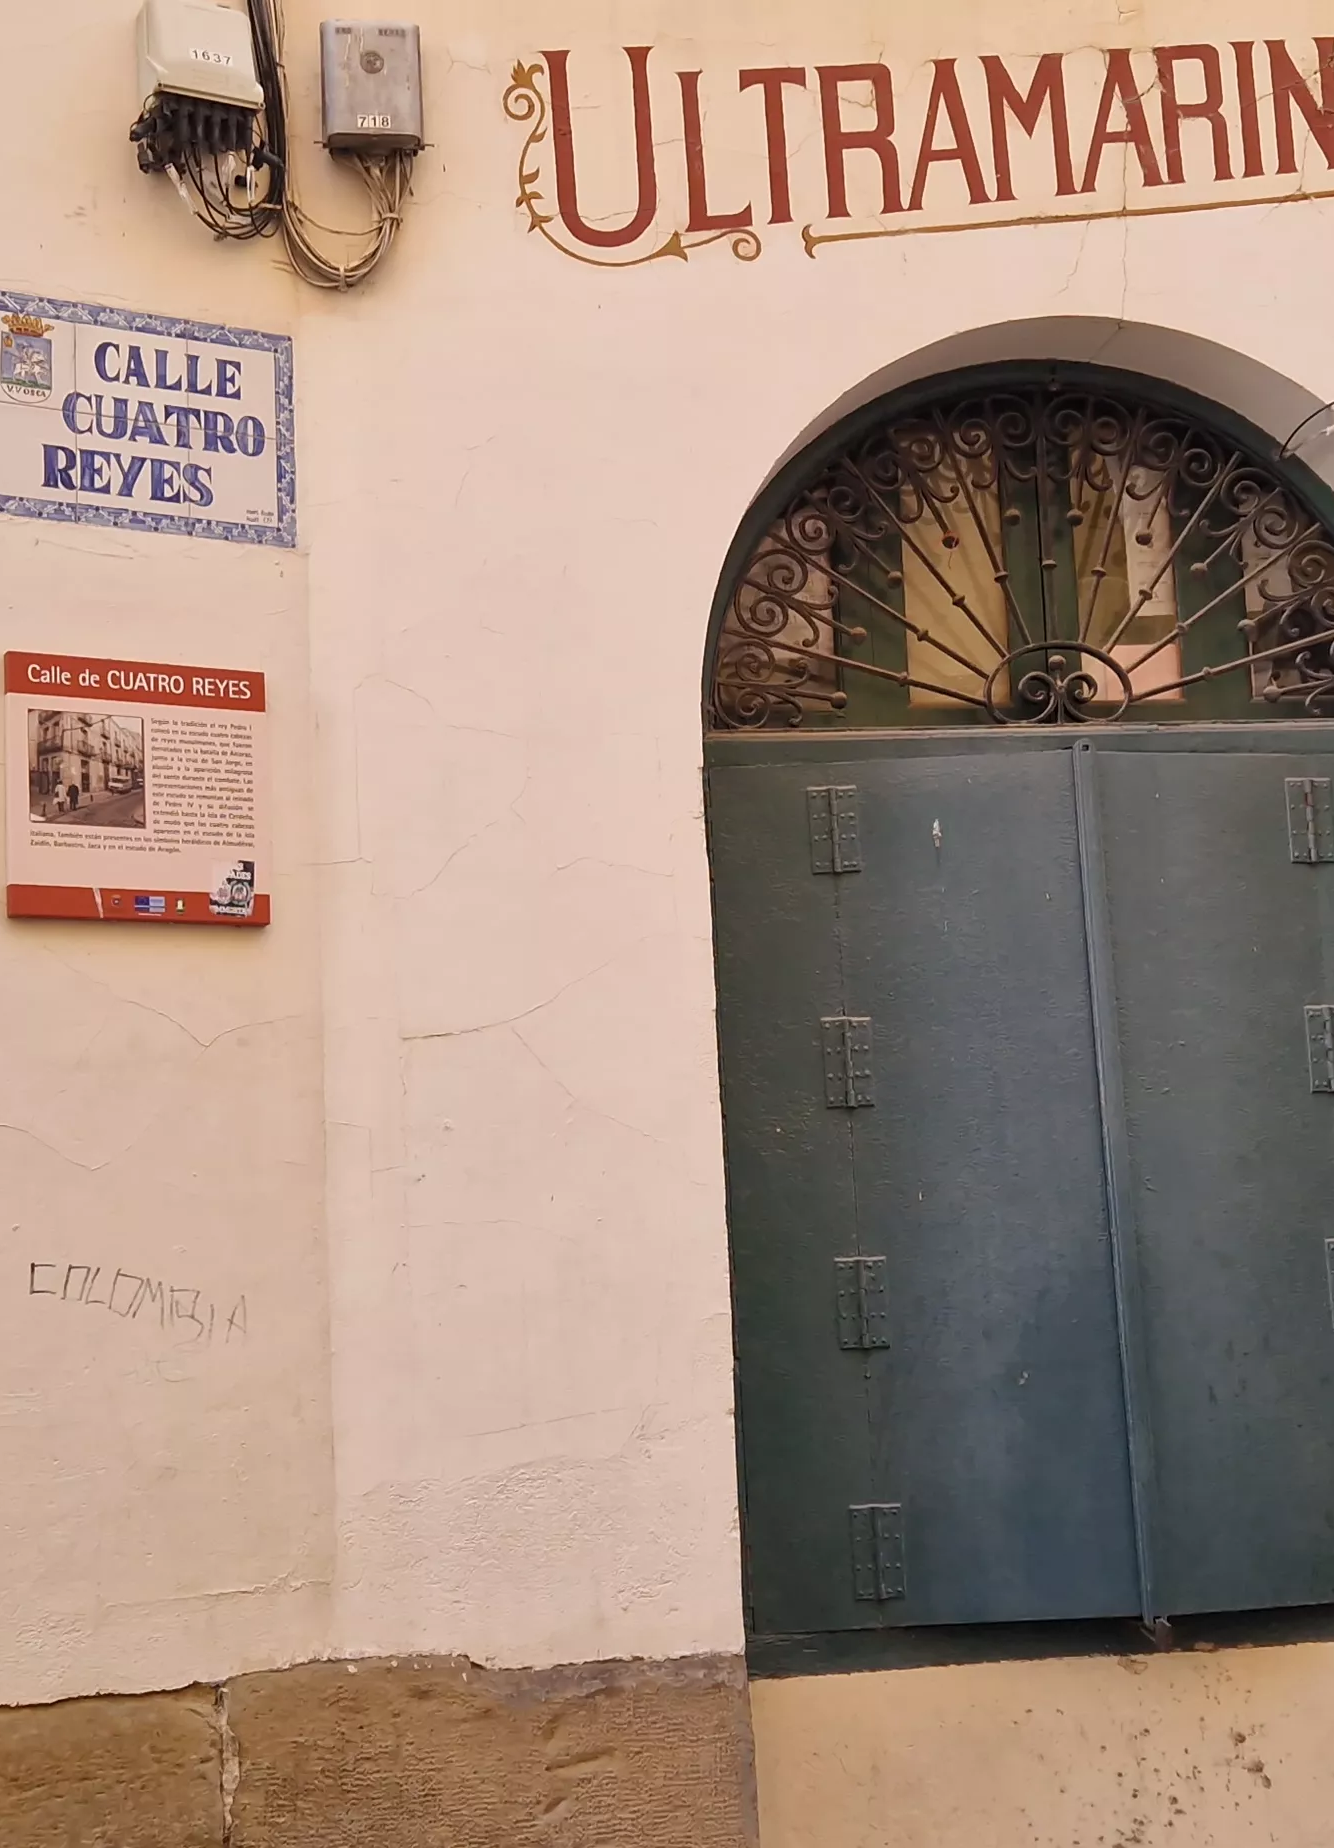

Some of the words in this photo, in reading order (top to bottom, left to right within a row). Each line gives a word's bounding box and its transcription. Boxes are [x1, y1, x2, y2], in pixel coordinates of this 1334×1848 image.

[192, 49, 231, 64] 1637
[358, 116, 390, 128] 718
[94, 341, 242, 400] CALLE
[62, 391, 266, 457] CUATRO
[41, 443, 214, 507] REYES
[27, 664, 71, 685] Calle
[78, 669, 100, 687] de
[106, 670, 185, 694] CUATRO
[192, 677, 251, 699] REYES
[28, 1262, 248, 1349] COLOMBIA
